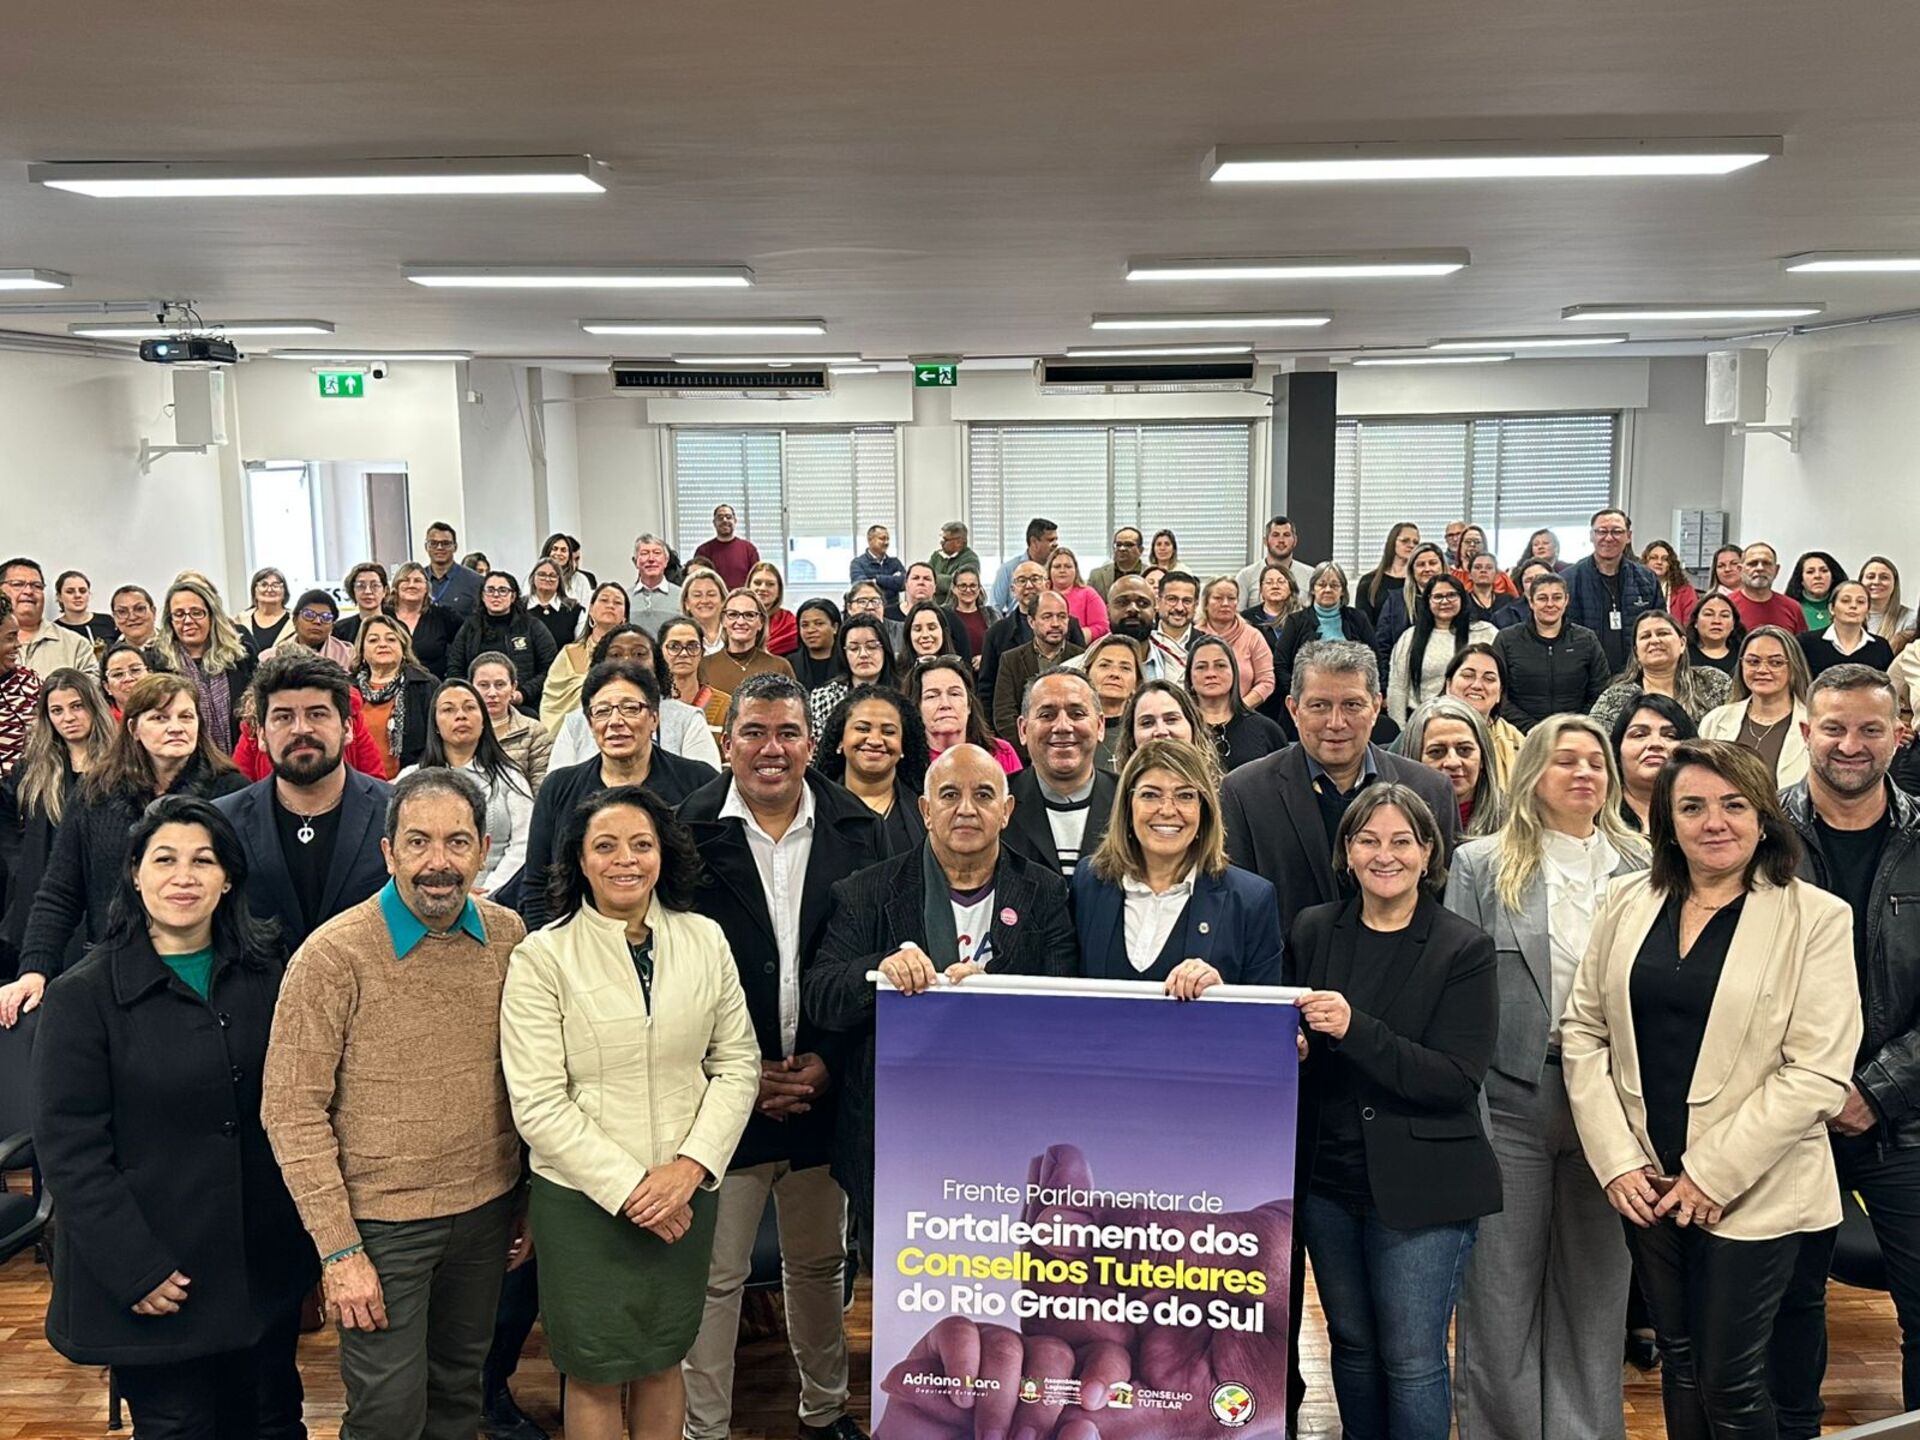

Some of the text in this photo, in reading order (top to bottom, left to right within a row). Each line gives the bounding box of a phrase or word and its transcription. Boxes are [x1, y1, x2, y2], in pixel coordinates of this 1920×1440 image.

[943, 1179, 1224, 1214] Frente Parlamentar de
[906, 1211, 1259, 1257] Fortalecimento dos
[896, 1247, 1267, 1295] Conselhos Tutelares
[897, 1283, 1265, 1333] do Rio Grande do Sul
[902, 1373, 1001, 1389] Adriana Lara
[1137, 1389, 1193, 1401] CONSELHO
[1138, 1398, 1182, 1410] TUTELAR
